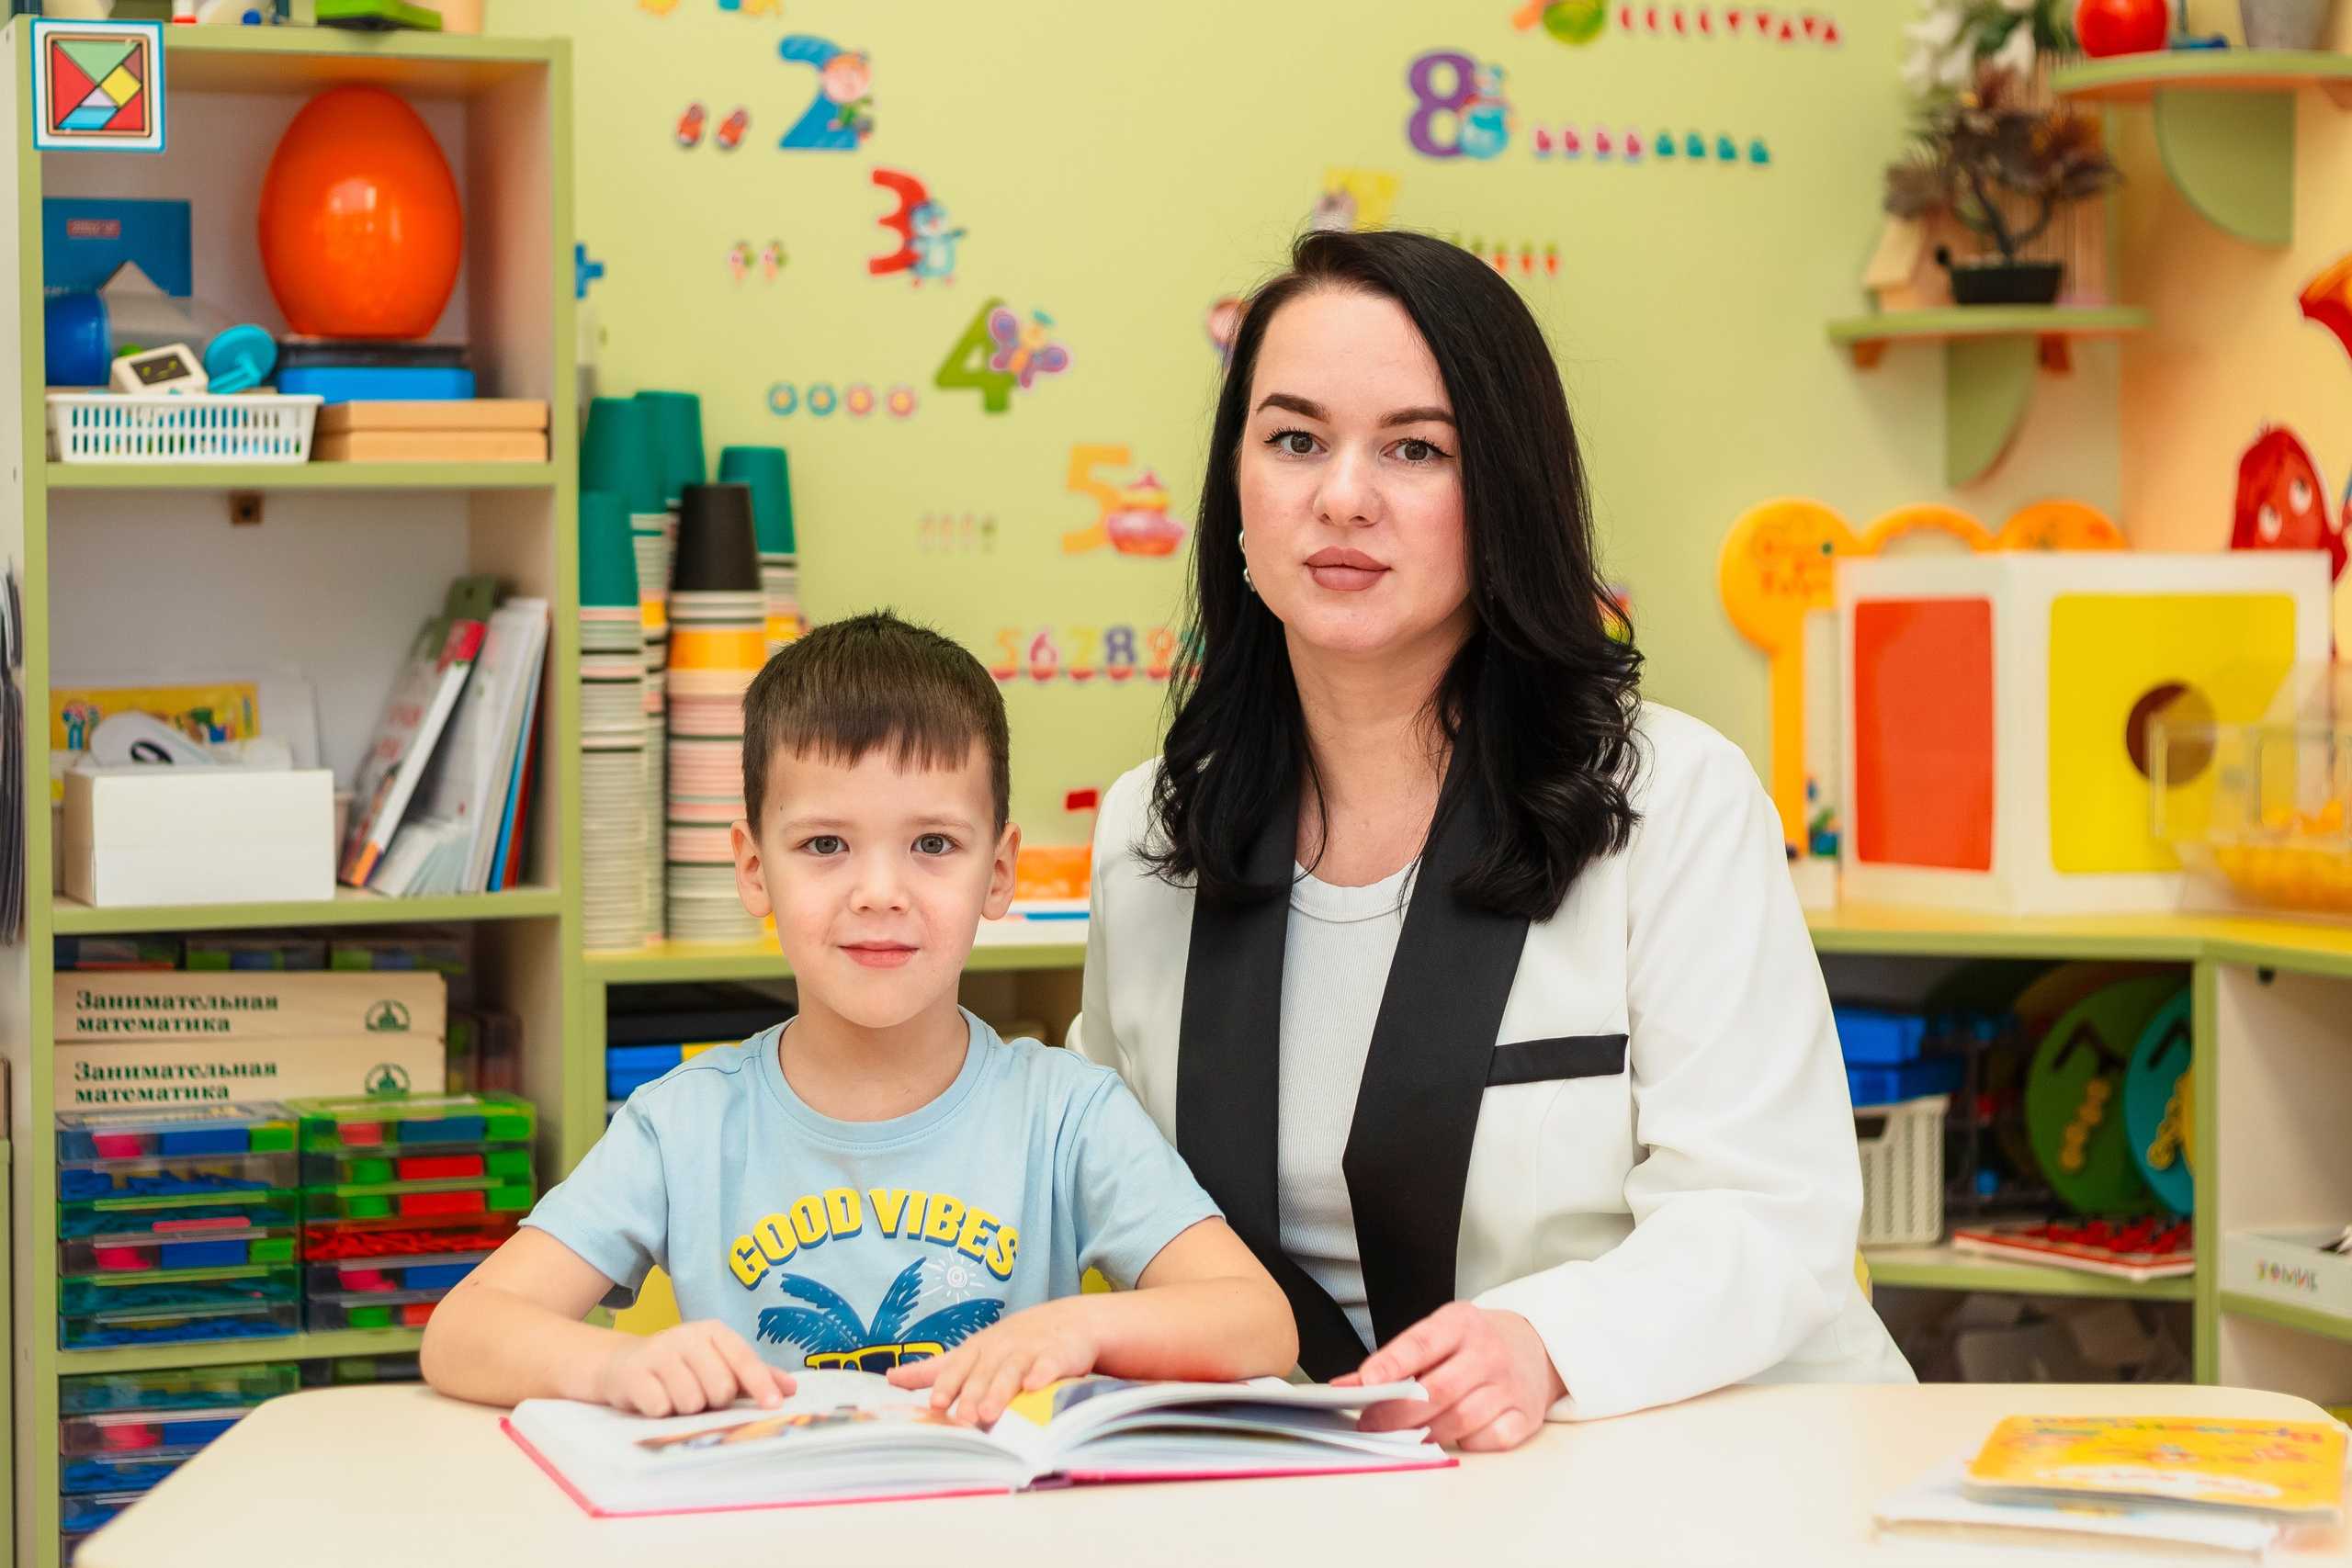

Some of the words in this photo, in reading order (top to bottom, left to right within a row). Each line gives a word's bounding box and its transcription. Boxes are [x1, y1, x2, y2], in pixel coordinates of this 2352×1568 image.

[778, 35, 860, 151] 2
[1408, 52, 1476, 159] 8
[867, 167, 932, 275] 3
[934, 299, 1020, 414] 4
[1061, 445, 1133, 555] 5
[75, 989, 279, 1012] Занимательная
[75, 1016, 231, 1033] математика
[74, 1061, 278, 1082] Занимательная
[74, 1084, 231, 1104] математика
[729, 1188, 863, 1291] GOOD
[869, 1189, 1020, 1281] VIBES
